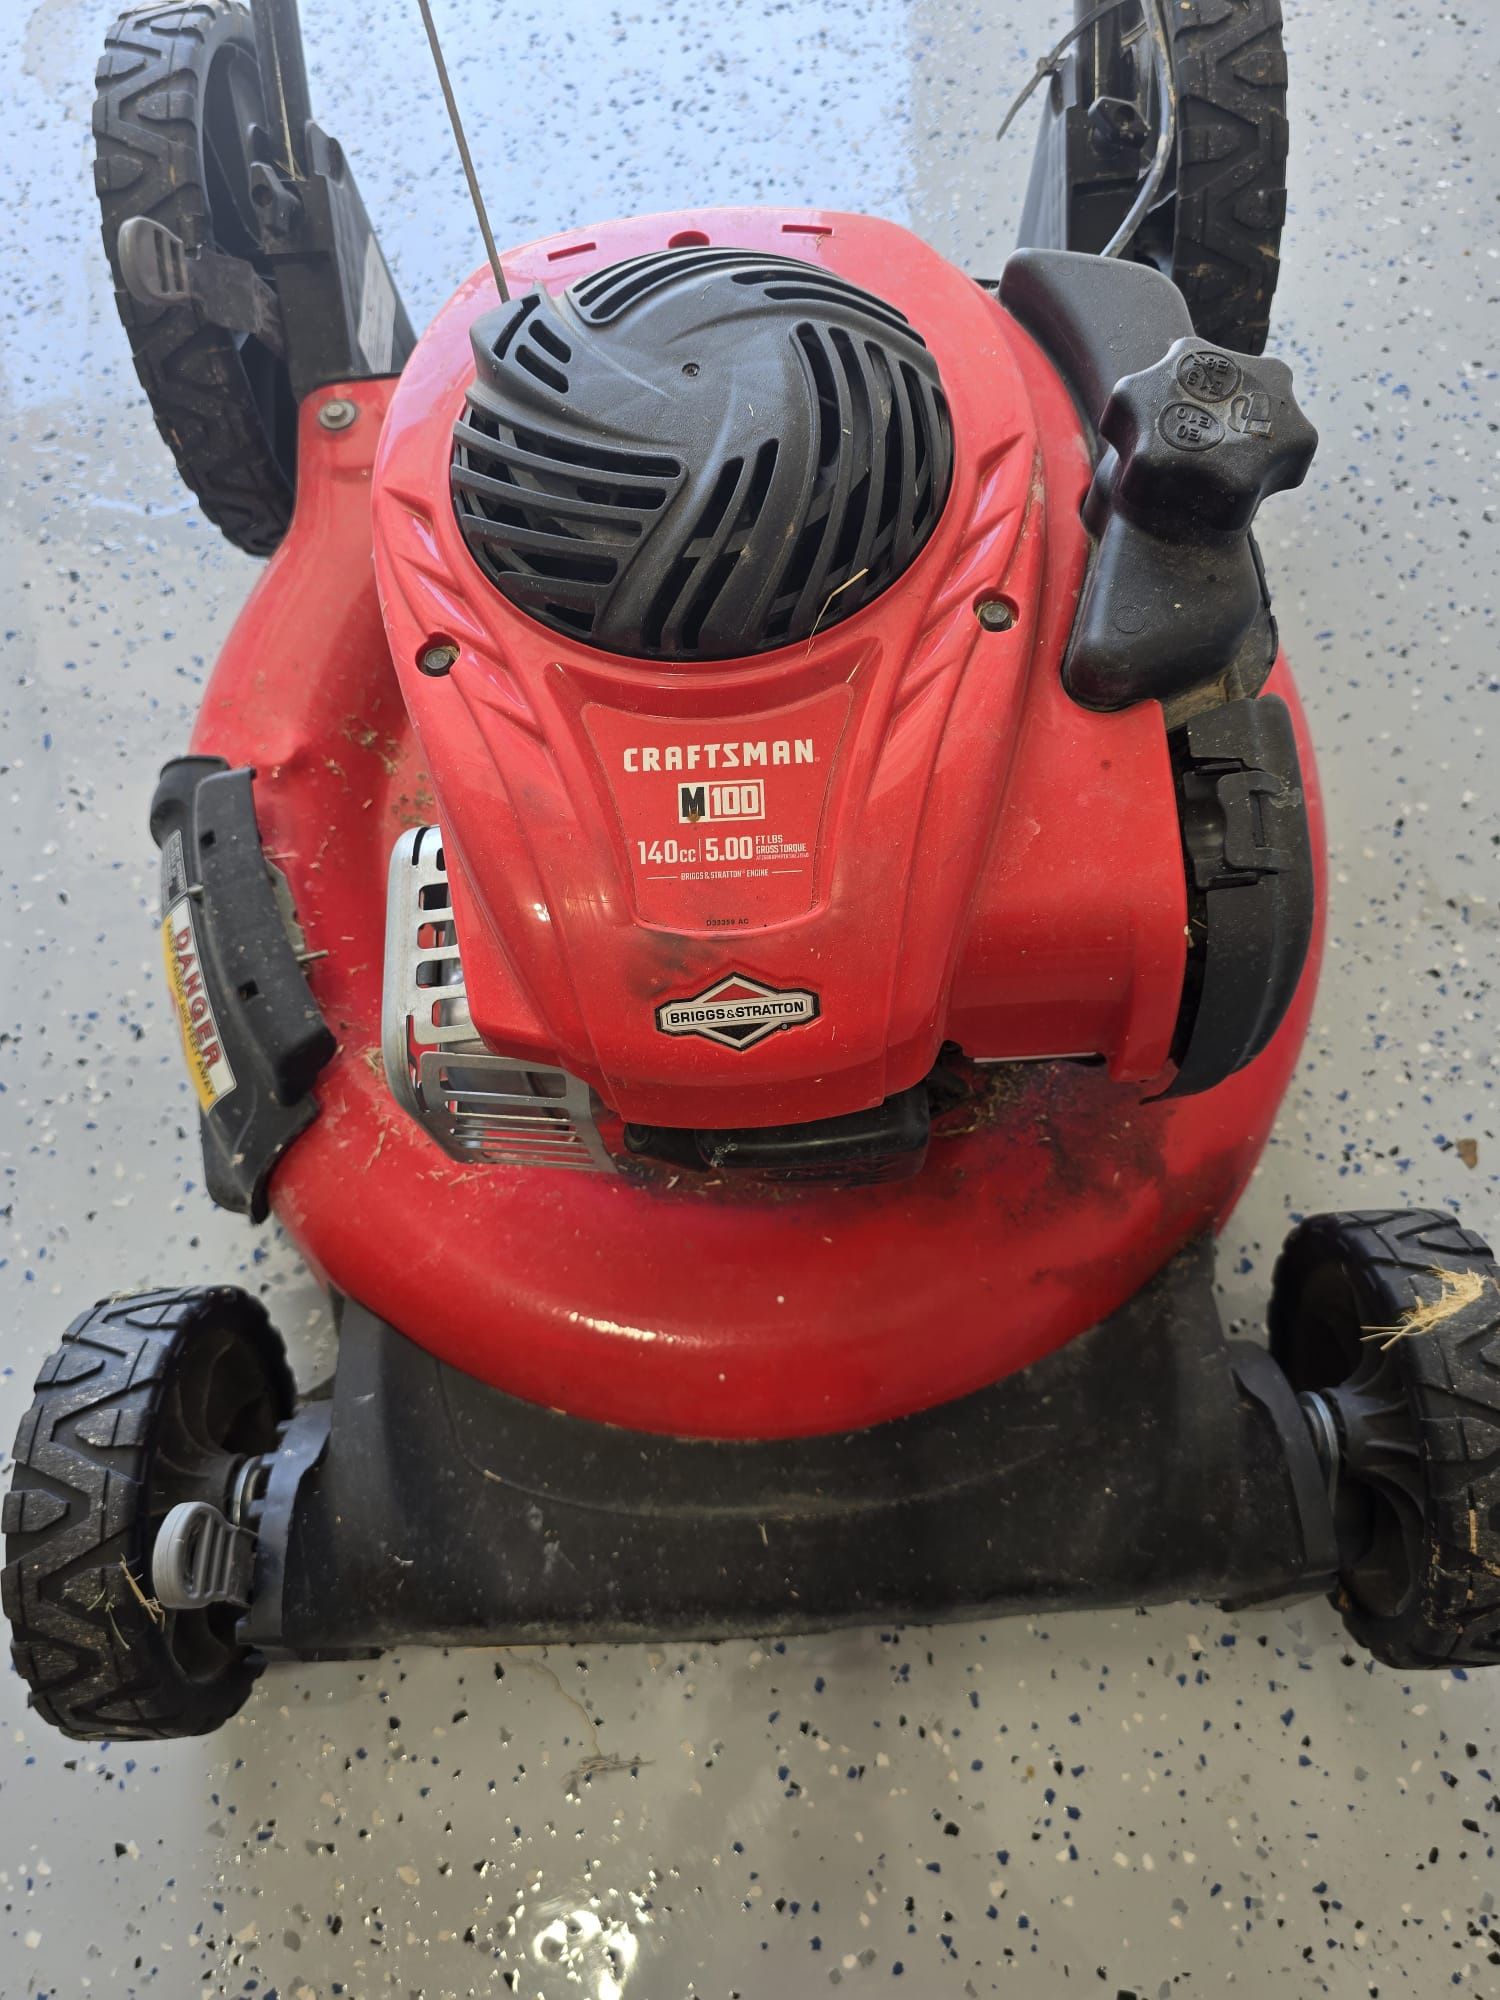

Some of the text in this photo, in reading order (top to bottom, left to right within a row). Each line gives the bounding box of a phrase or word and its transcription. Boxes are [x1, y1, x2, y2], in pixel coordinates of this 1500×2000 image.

[1176, 407, 1212, 430] E10
[623, 738, 815, 773] CRAFTSMAN
[637, 836, 753, 865] 140cc 5.00
[755, 834, 783, 845] FT LBS
[756, 842, 807, 855] GROSS TORQUE
[746, 869, 769, 877] ENGINE
[175, 927, 222, 1069] DANGER
[197, 1061, 215, 1096] AWAY
